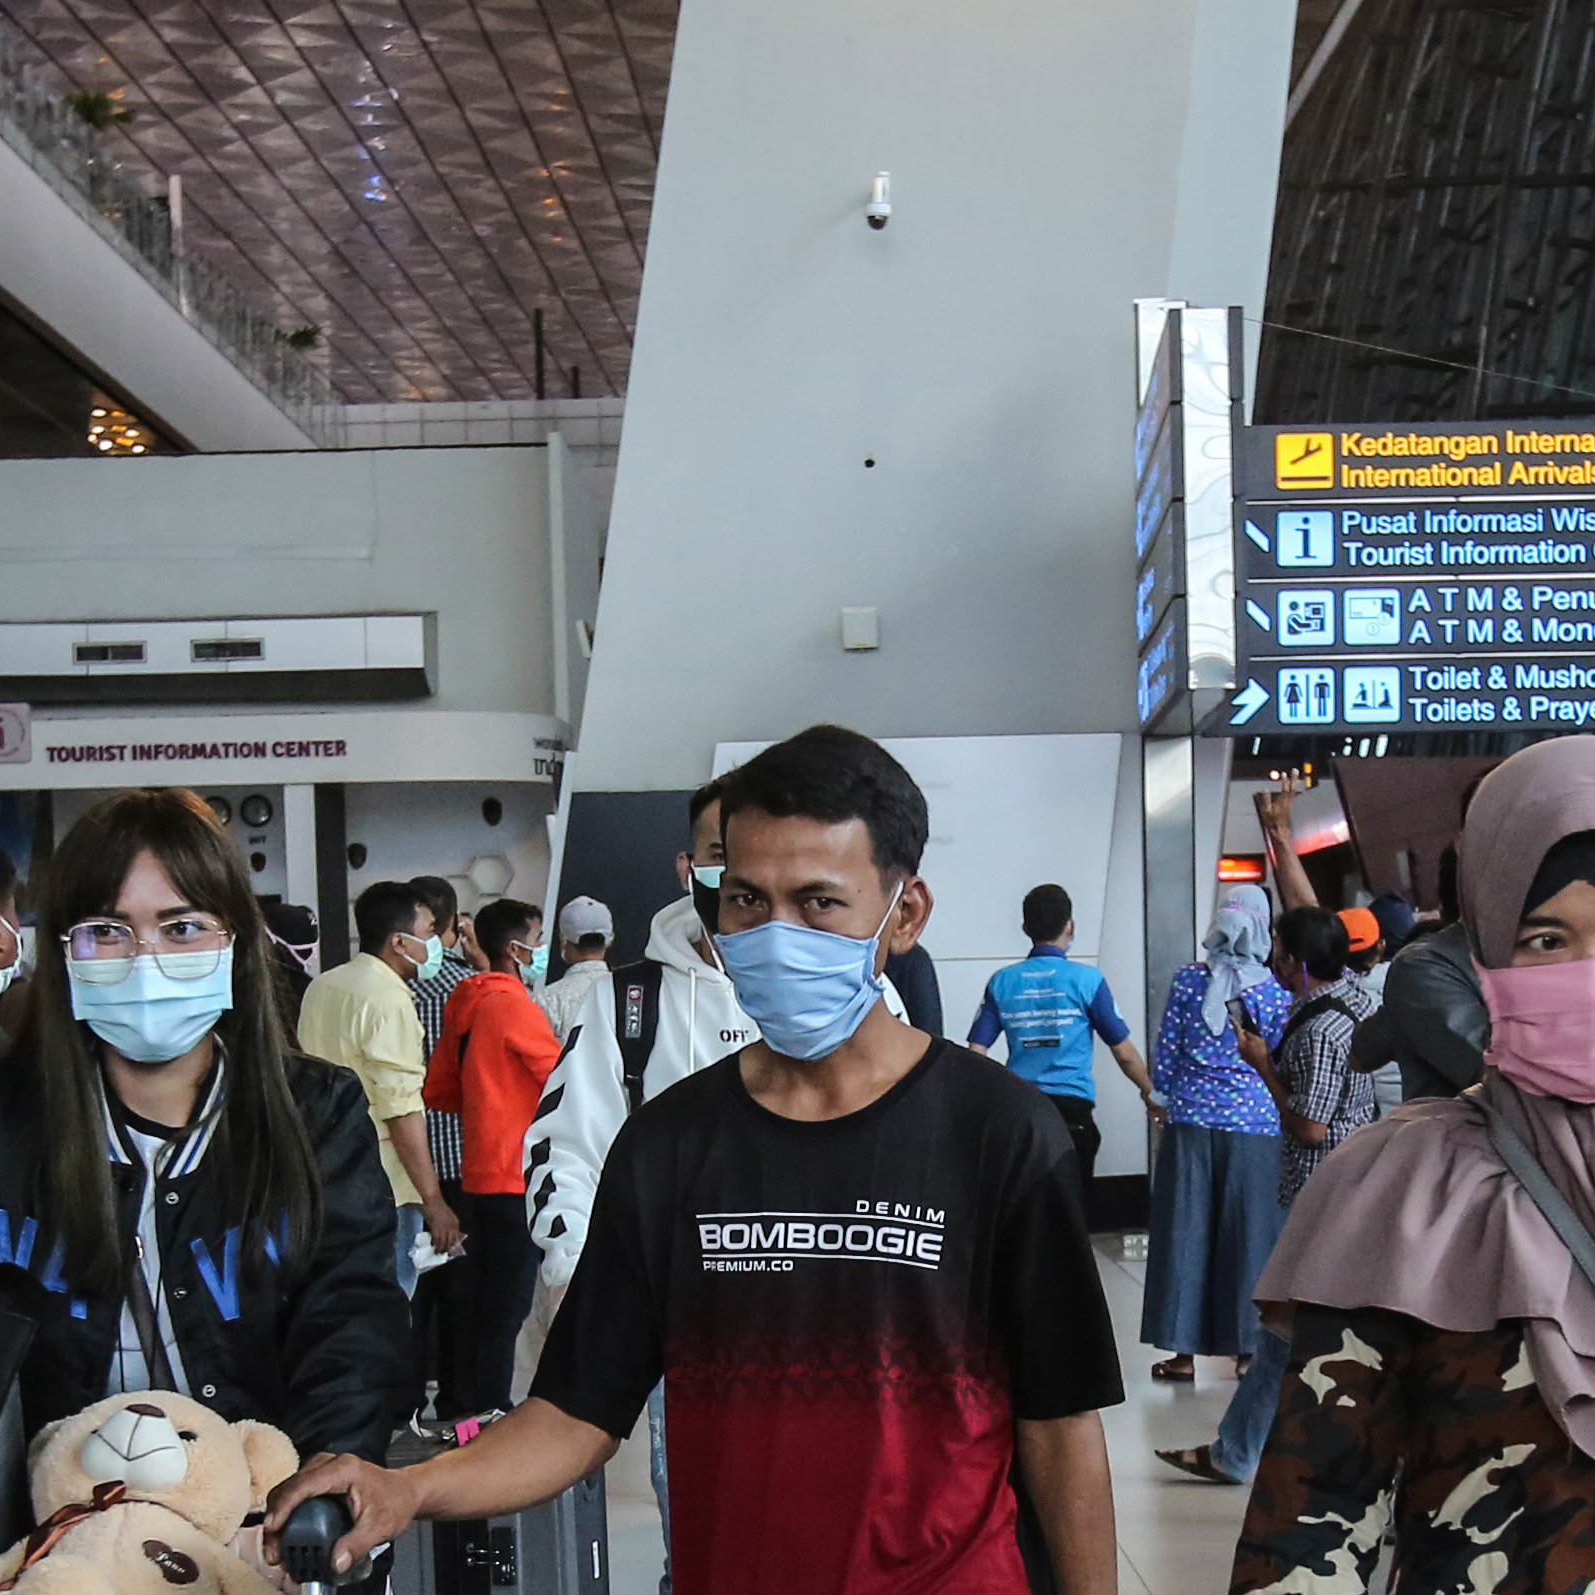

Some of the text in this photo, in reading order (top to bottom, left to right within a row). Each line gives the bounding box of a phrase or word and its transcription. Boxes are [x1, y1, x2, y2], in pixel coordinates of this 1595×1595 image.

[1341, 432, 1499, 460] Kedatangan
[1341, 462, 1502, 488] International
[1342, 510, 1417, 534] Pusat
[1426, 508, 1544, 533] Informasi
[1343, 542, 1434, 566] Tourist
[1442, 539, 1586, 565] Information
[1502, 586, 1524, 611] &
[1502, 618, 1524, 643] &
[1408, 666, 1481, 690] Toilet
[1487, 665, 1507, 689] &
[1408, 698, 1496, 722] Toilets
[1502, 697, 1522, 721] &
[46, 739, 348, 763] TOURIST INFORMATION CENTER
[856, 1199, 946, 1223] DENIM
[699, 1222, 944, 1262] BOMBOOGIE
[703, 1259, 794, 1273] PREMIUM.CO
